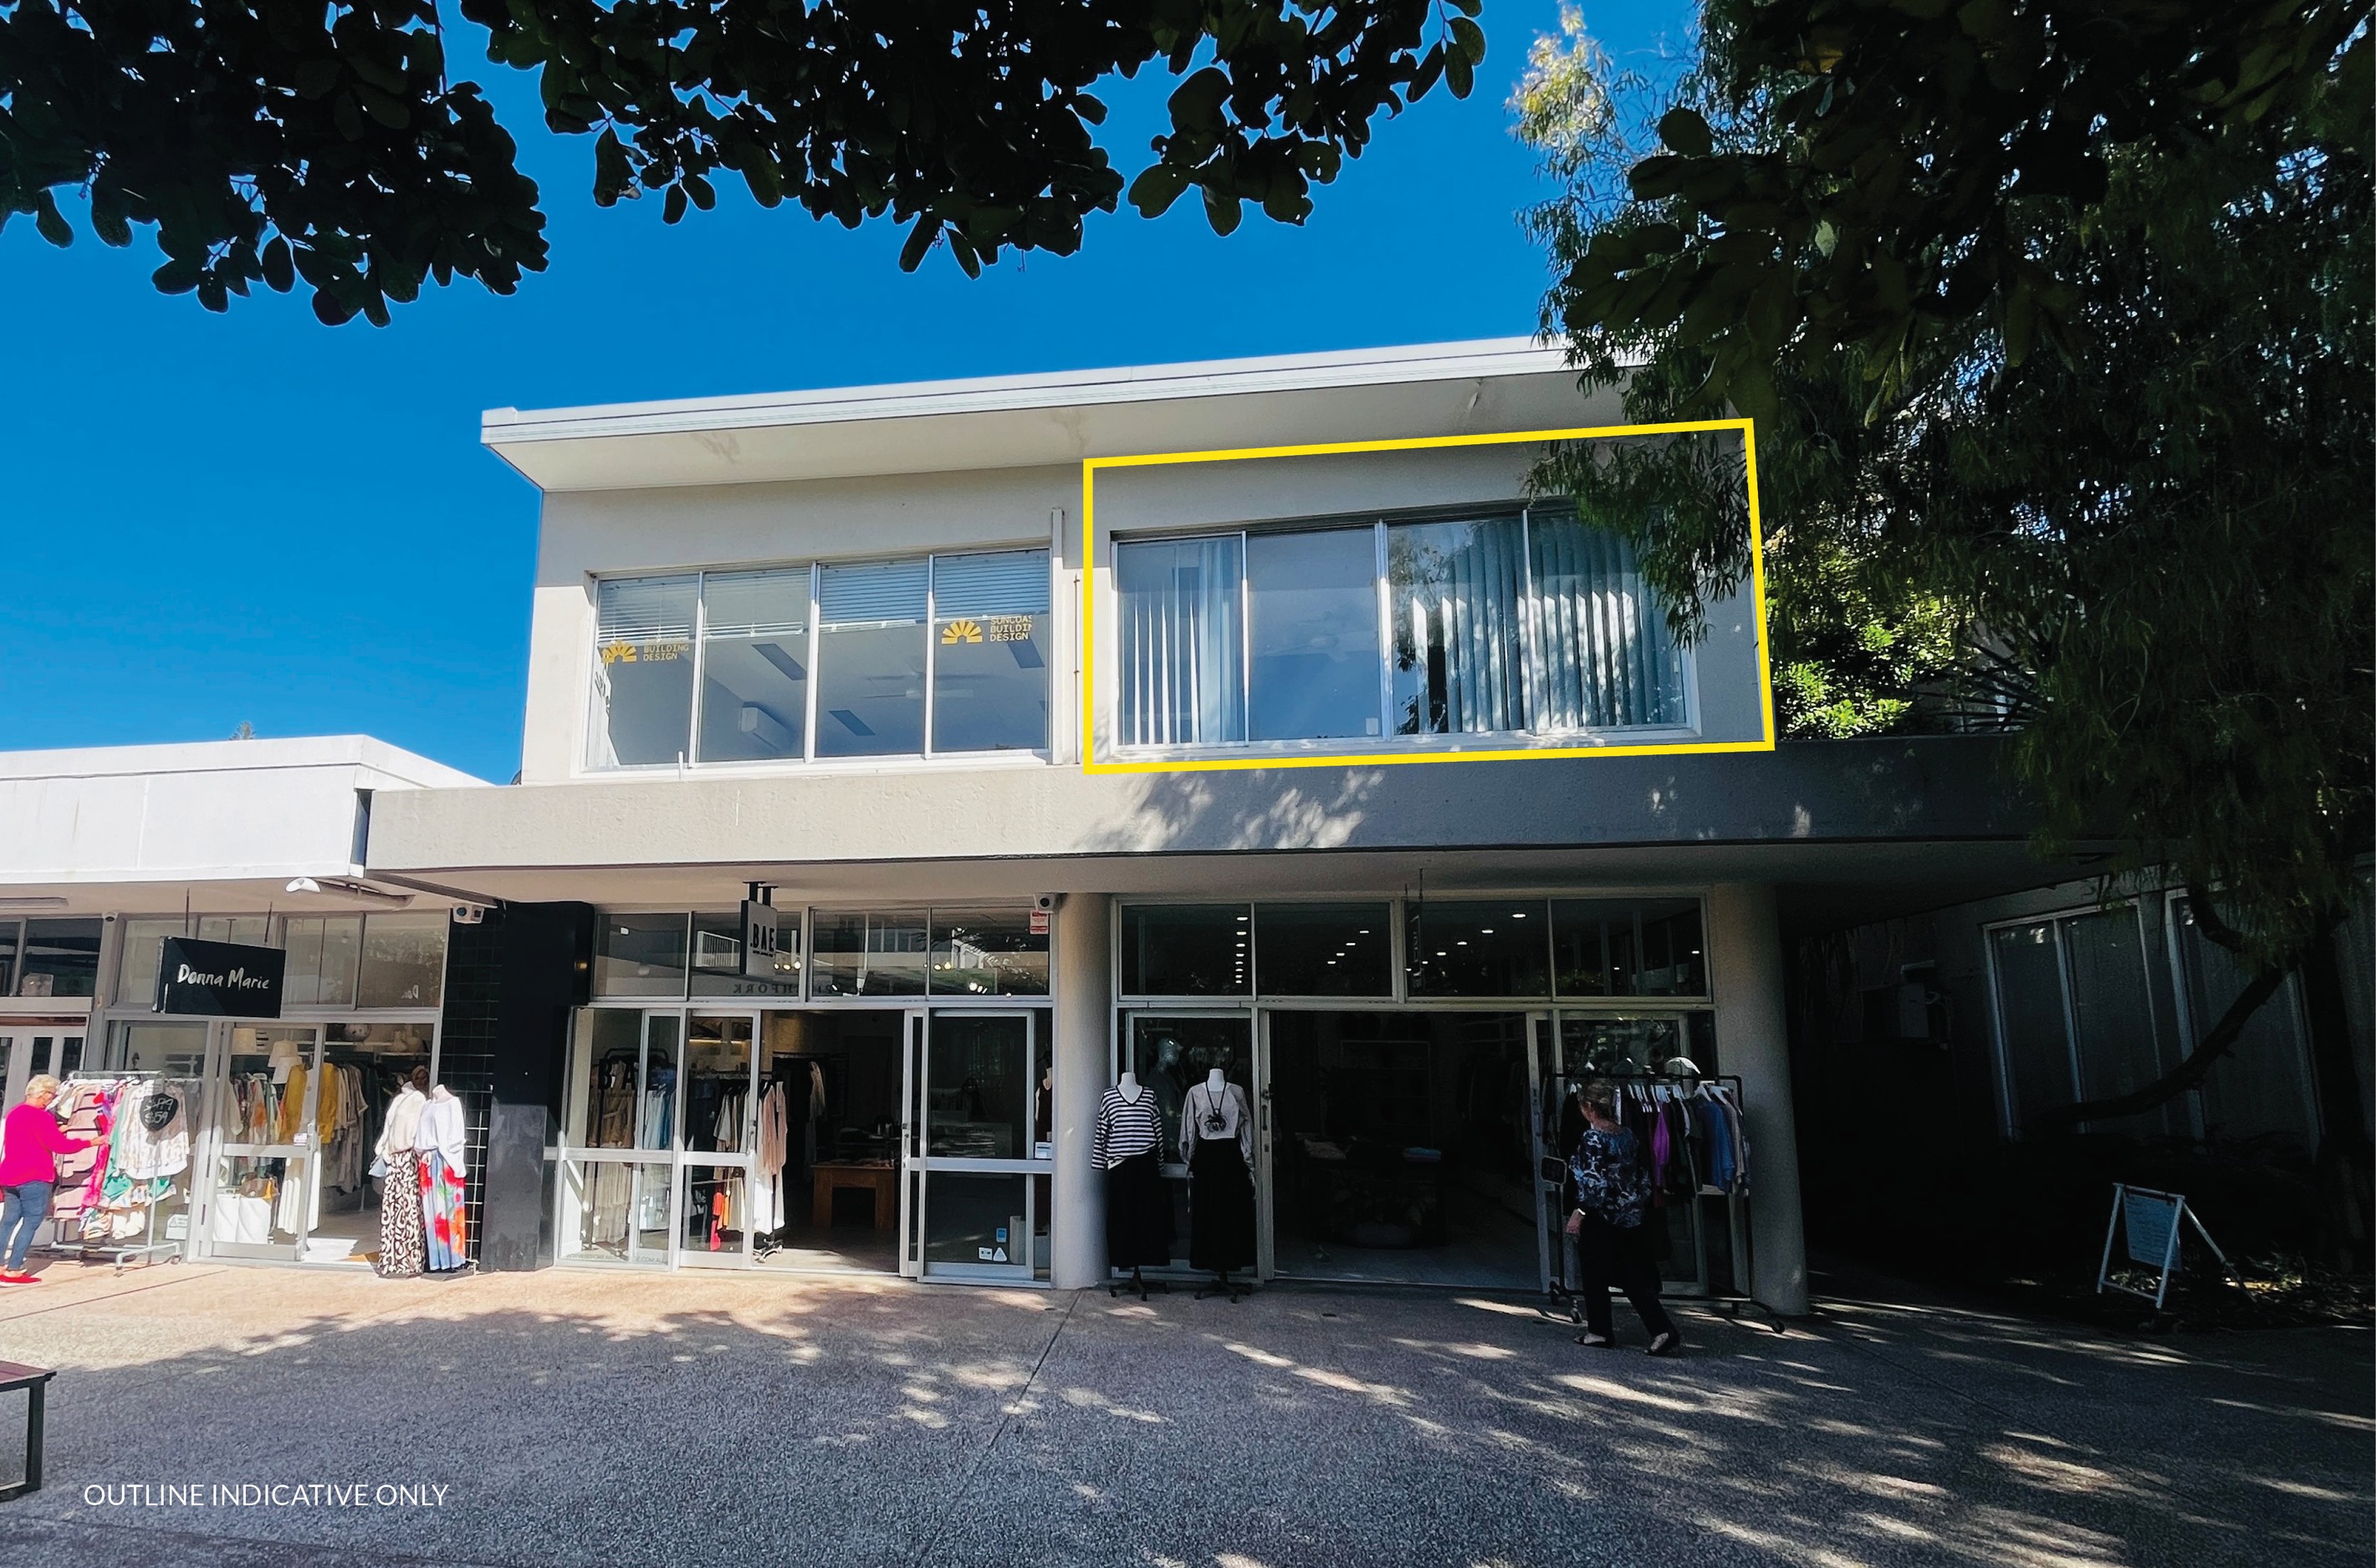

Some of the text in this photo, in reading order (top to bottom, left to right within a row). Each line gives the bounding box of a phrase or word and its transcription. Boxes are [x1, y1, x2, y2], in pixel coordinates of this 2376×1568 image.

[990, 631, 1029, 642] DESIGN
[644, 643, 689, 653] BUILDING
[643, 651, 677, 661] DESIGN
[176, 963, 270, 991] Donna Marie
